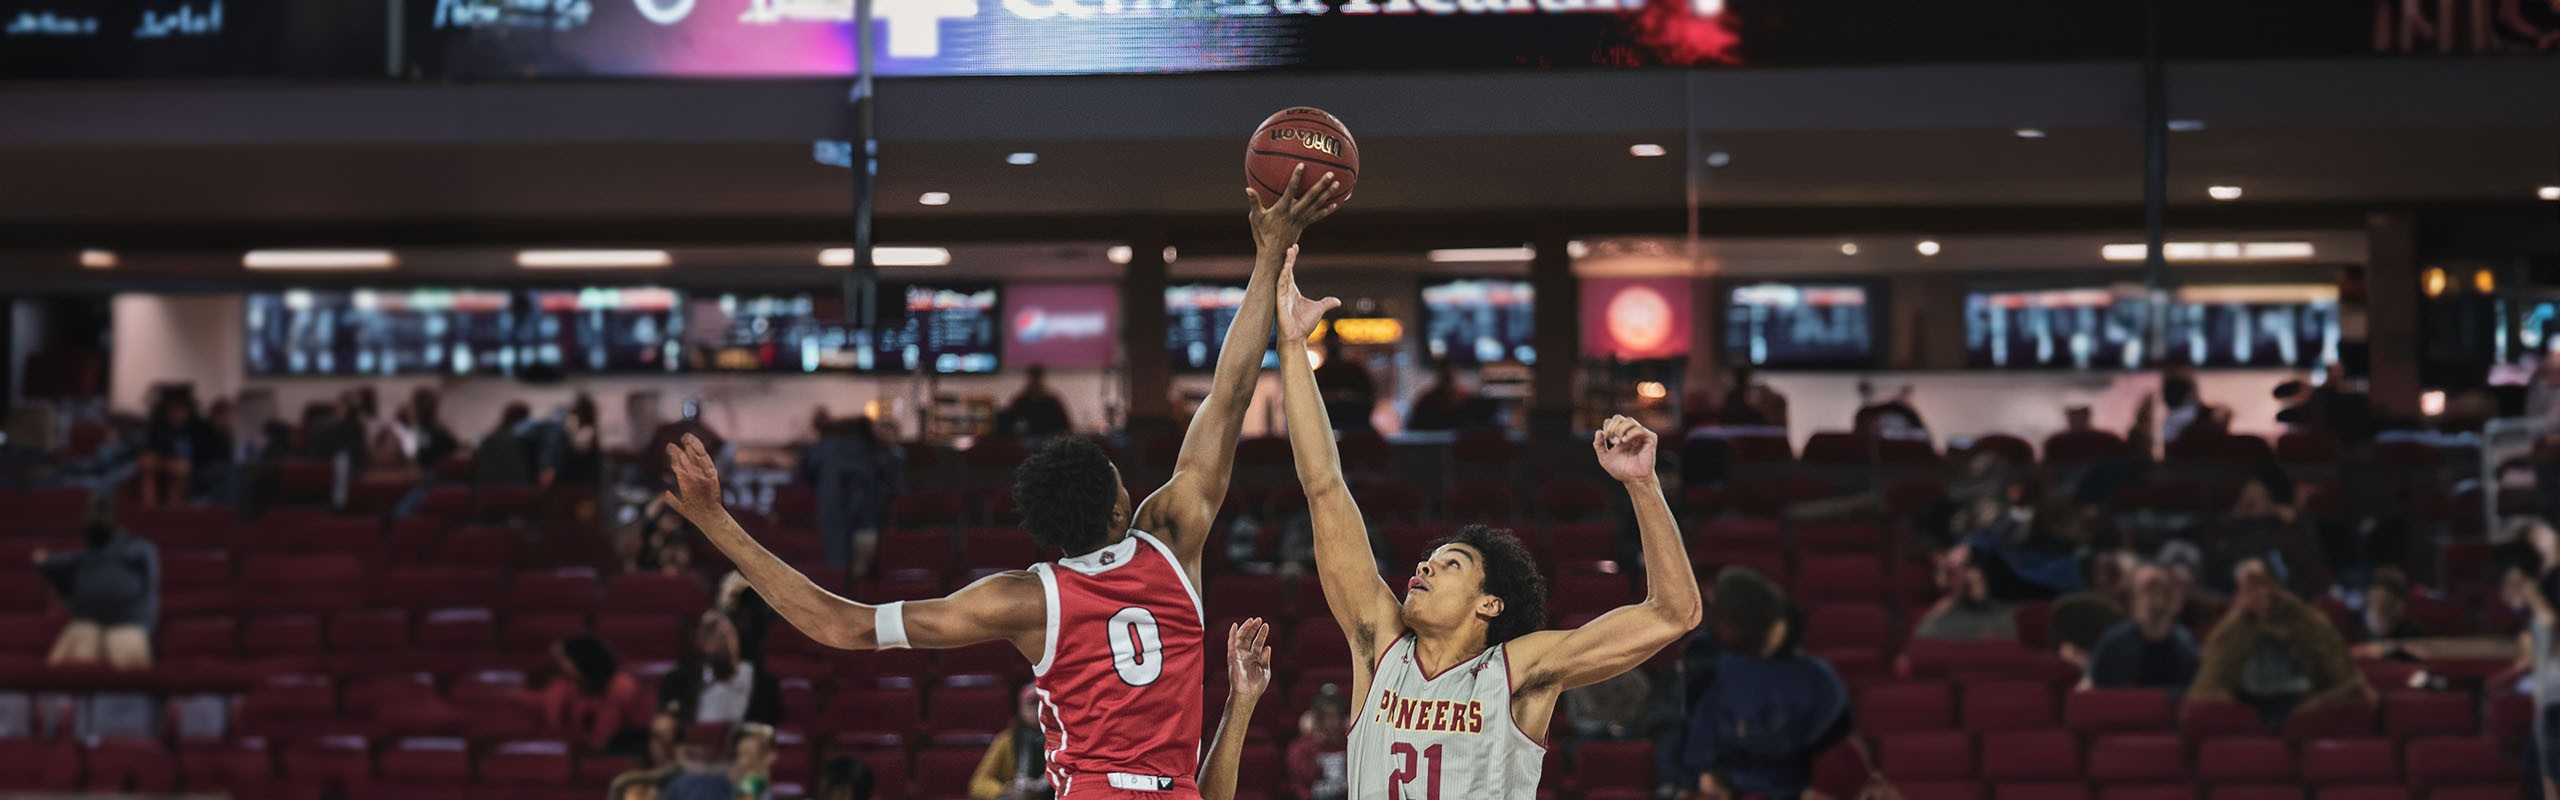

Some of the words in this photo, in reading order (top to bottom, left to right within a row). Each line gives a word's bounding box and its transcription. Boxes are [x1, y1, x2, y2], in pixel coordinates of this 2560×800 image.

[1270, 127, 1343, 158] Wilson
[1106, 605, 1164, 687] 0
[1388, 741, 1443, 800] 21
